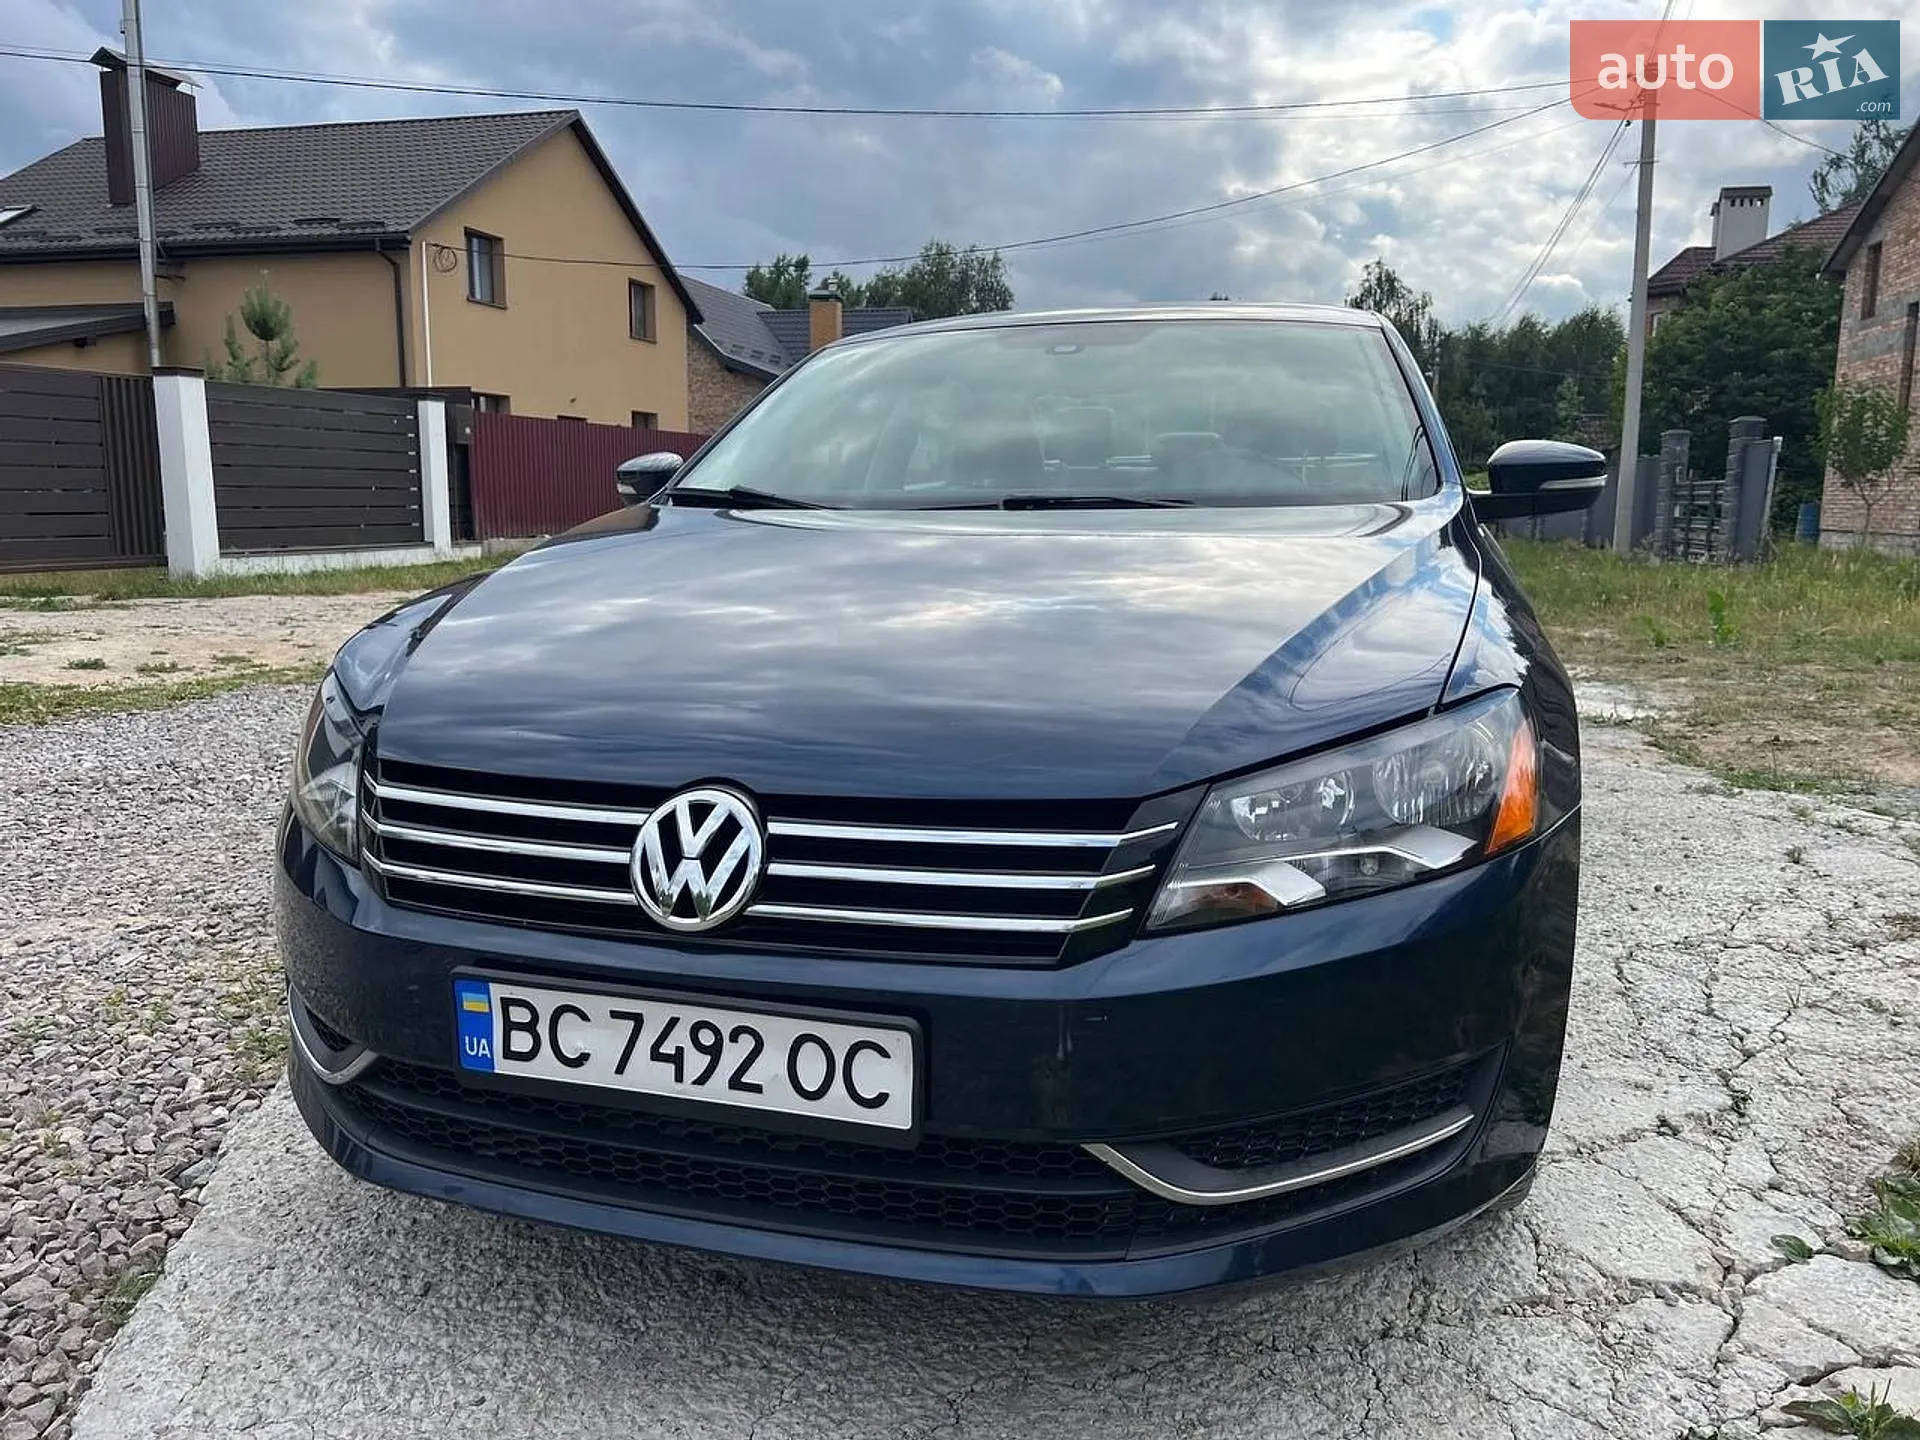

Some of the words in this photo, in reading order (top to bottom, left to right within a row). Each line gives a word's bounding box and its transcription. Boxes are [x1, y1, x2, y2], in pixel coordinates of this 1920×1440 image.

[464, 1034, 492, 1059] UA
[499, 995, 592, 1069] BC
[608, 1009, 766, 1095] 7492
[786, 1032, 892, 1110] OC
